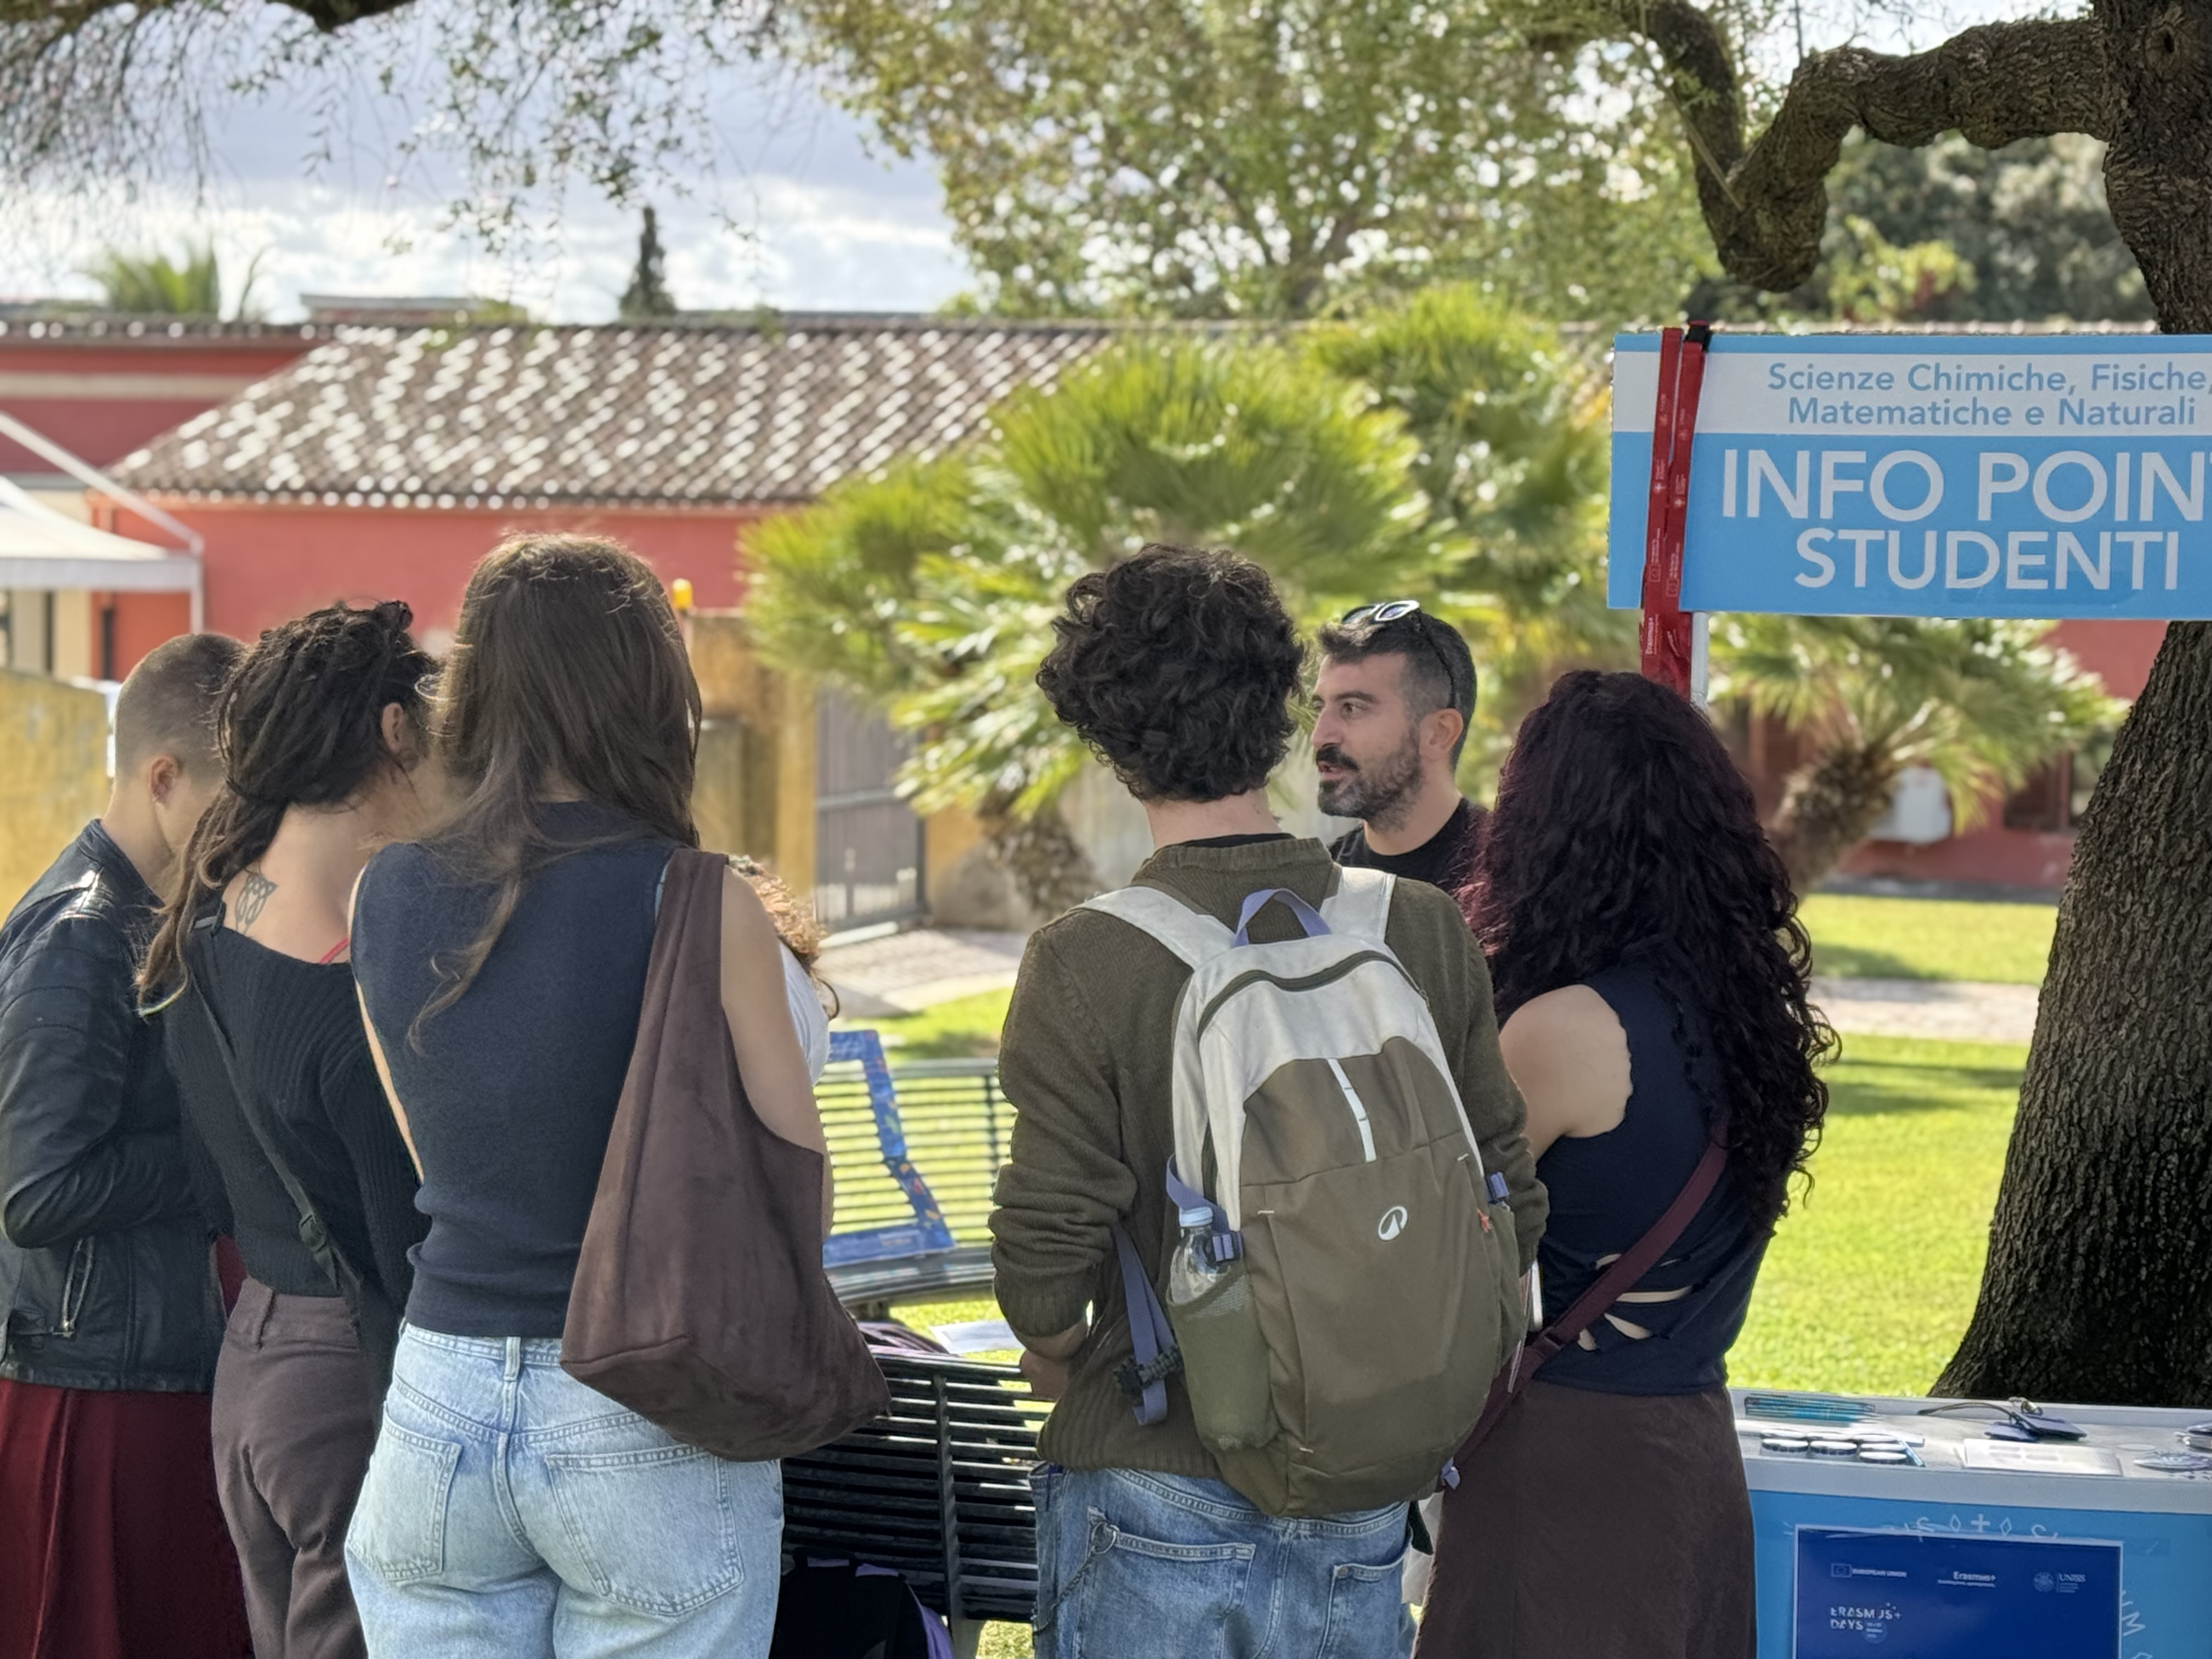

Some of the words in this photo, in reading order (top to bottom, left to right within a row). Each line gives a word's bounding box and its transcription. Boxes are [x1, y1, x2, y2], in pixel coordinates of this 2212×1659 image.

[1768, 363, 1894, 391] Scienze
[1907, 363, 2077, 396] Chimiche,
[1787, 396, 2012, 426] Matematiche
[2024, 406, 2045, 426] e
[2057, 396, 2196, 426] Naturali
[1723, 448, 1944, 522] INFO
[1977, 450, 2212, 523] POIN
[1794, 527, 2179, 590] STUDENTI
[1830, 1619, 1864, 1631] DAYS
